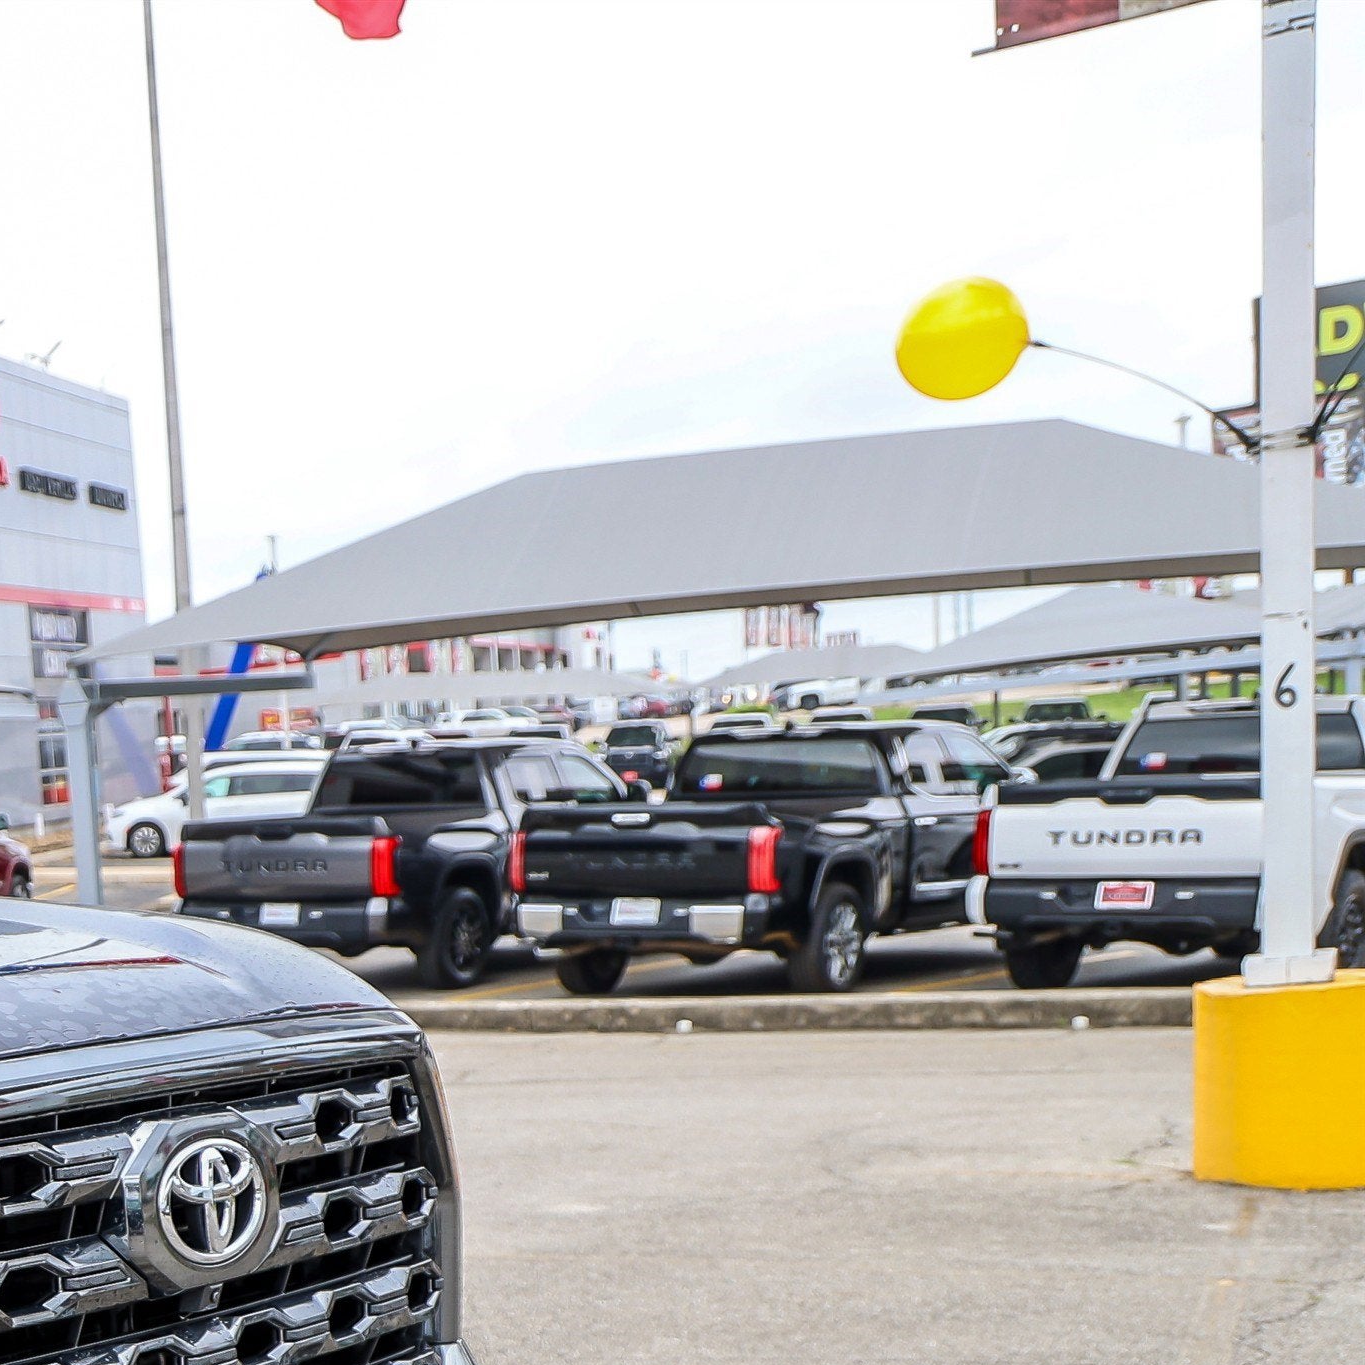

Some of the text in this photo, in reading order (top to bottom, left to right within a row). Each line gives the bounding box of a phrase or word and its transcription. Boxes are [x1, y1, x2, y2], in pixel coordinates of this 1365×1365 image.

[1274, 662, 1297, 708] 6
[1047, 828, 1205, 847] TUNDRA
[219, 859, 329, 875] TUNDRA
